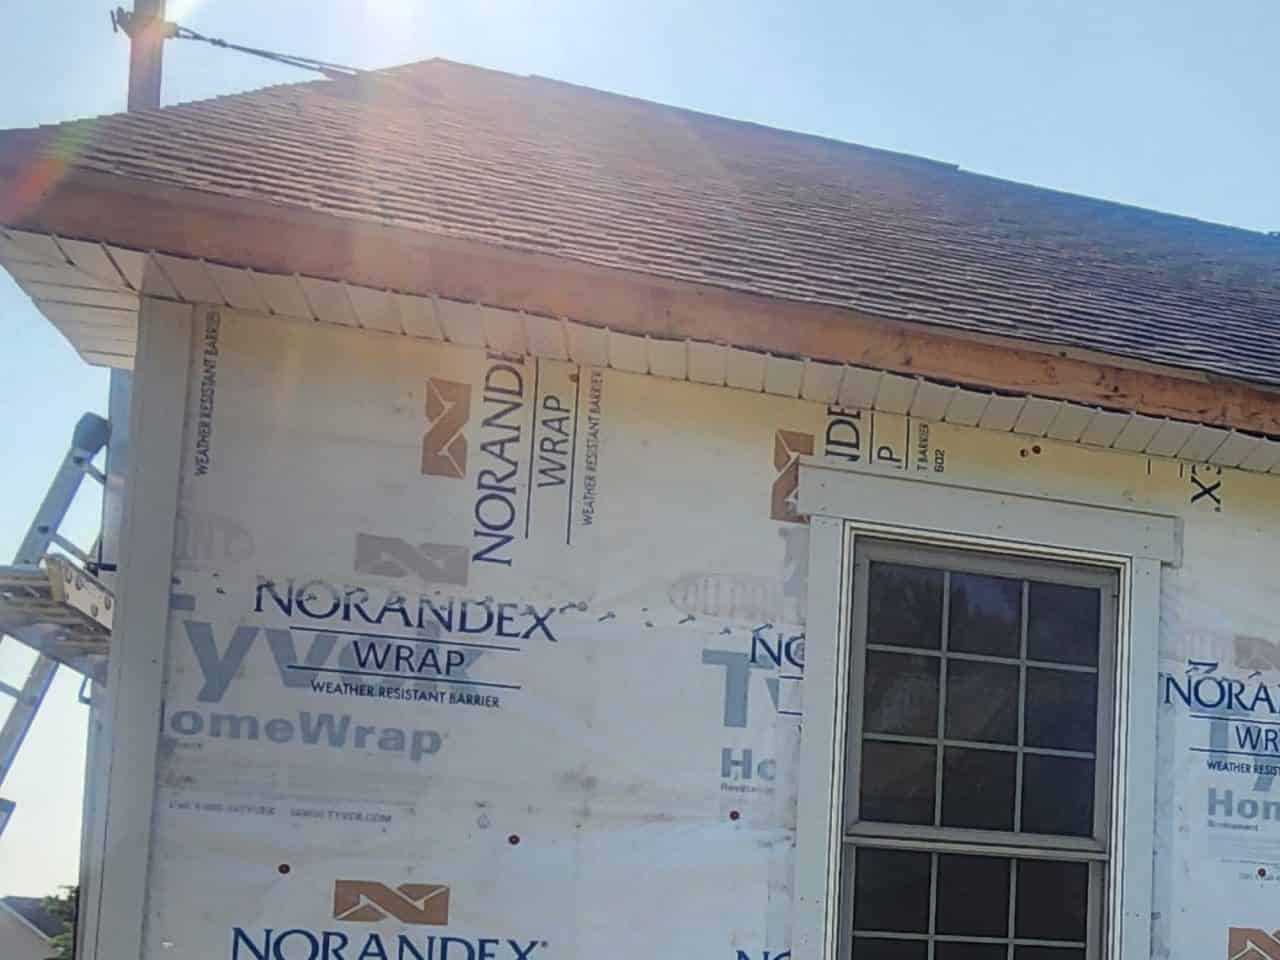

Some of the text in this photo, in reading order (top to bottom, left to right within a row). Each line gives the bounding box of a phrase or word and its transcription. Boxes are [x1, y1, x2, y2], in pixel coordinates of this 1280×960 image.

[537, 395, 571, 488] WRAP
[582, 475, 595, 526] WEATHER
[253, 573, 558, 642] NORANDEX
[353, 641, 465, 676] WRAP
[310, 680, 500, 708] WEATHER RESISTANT BARRIER
[1206, 760, 1251, 774] WEATHER
